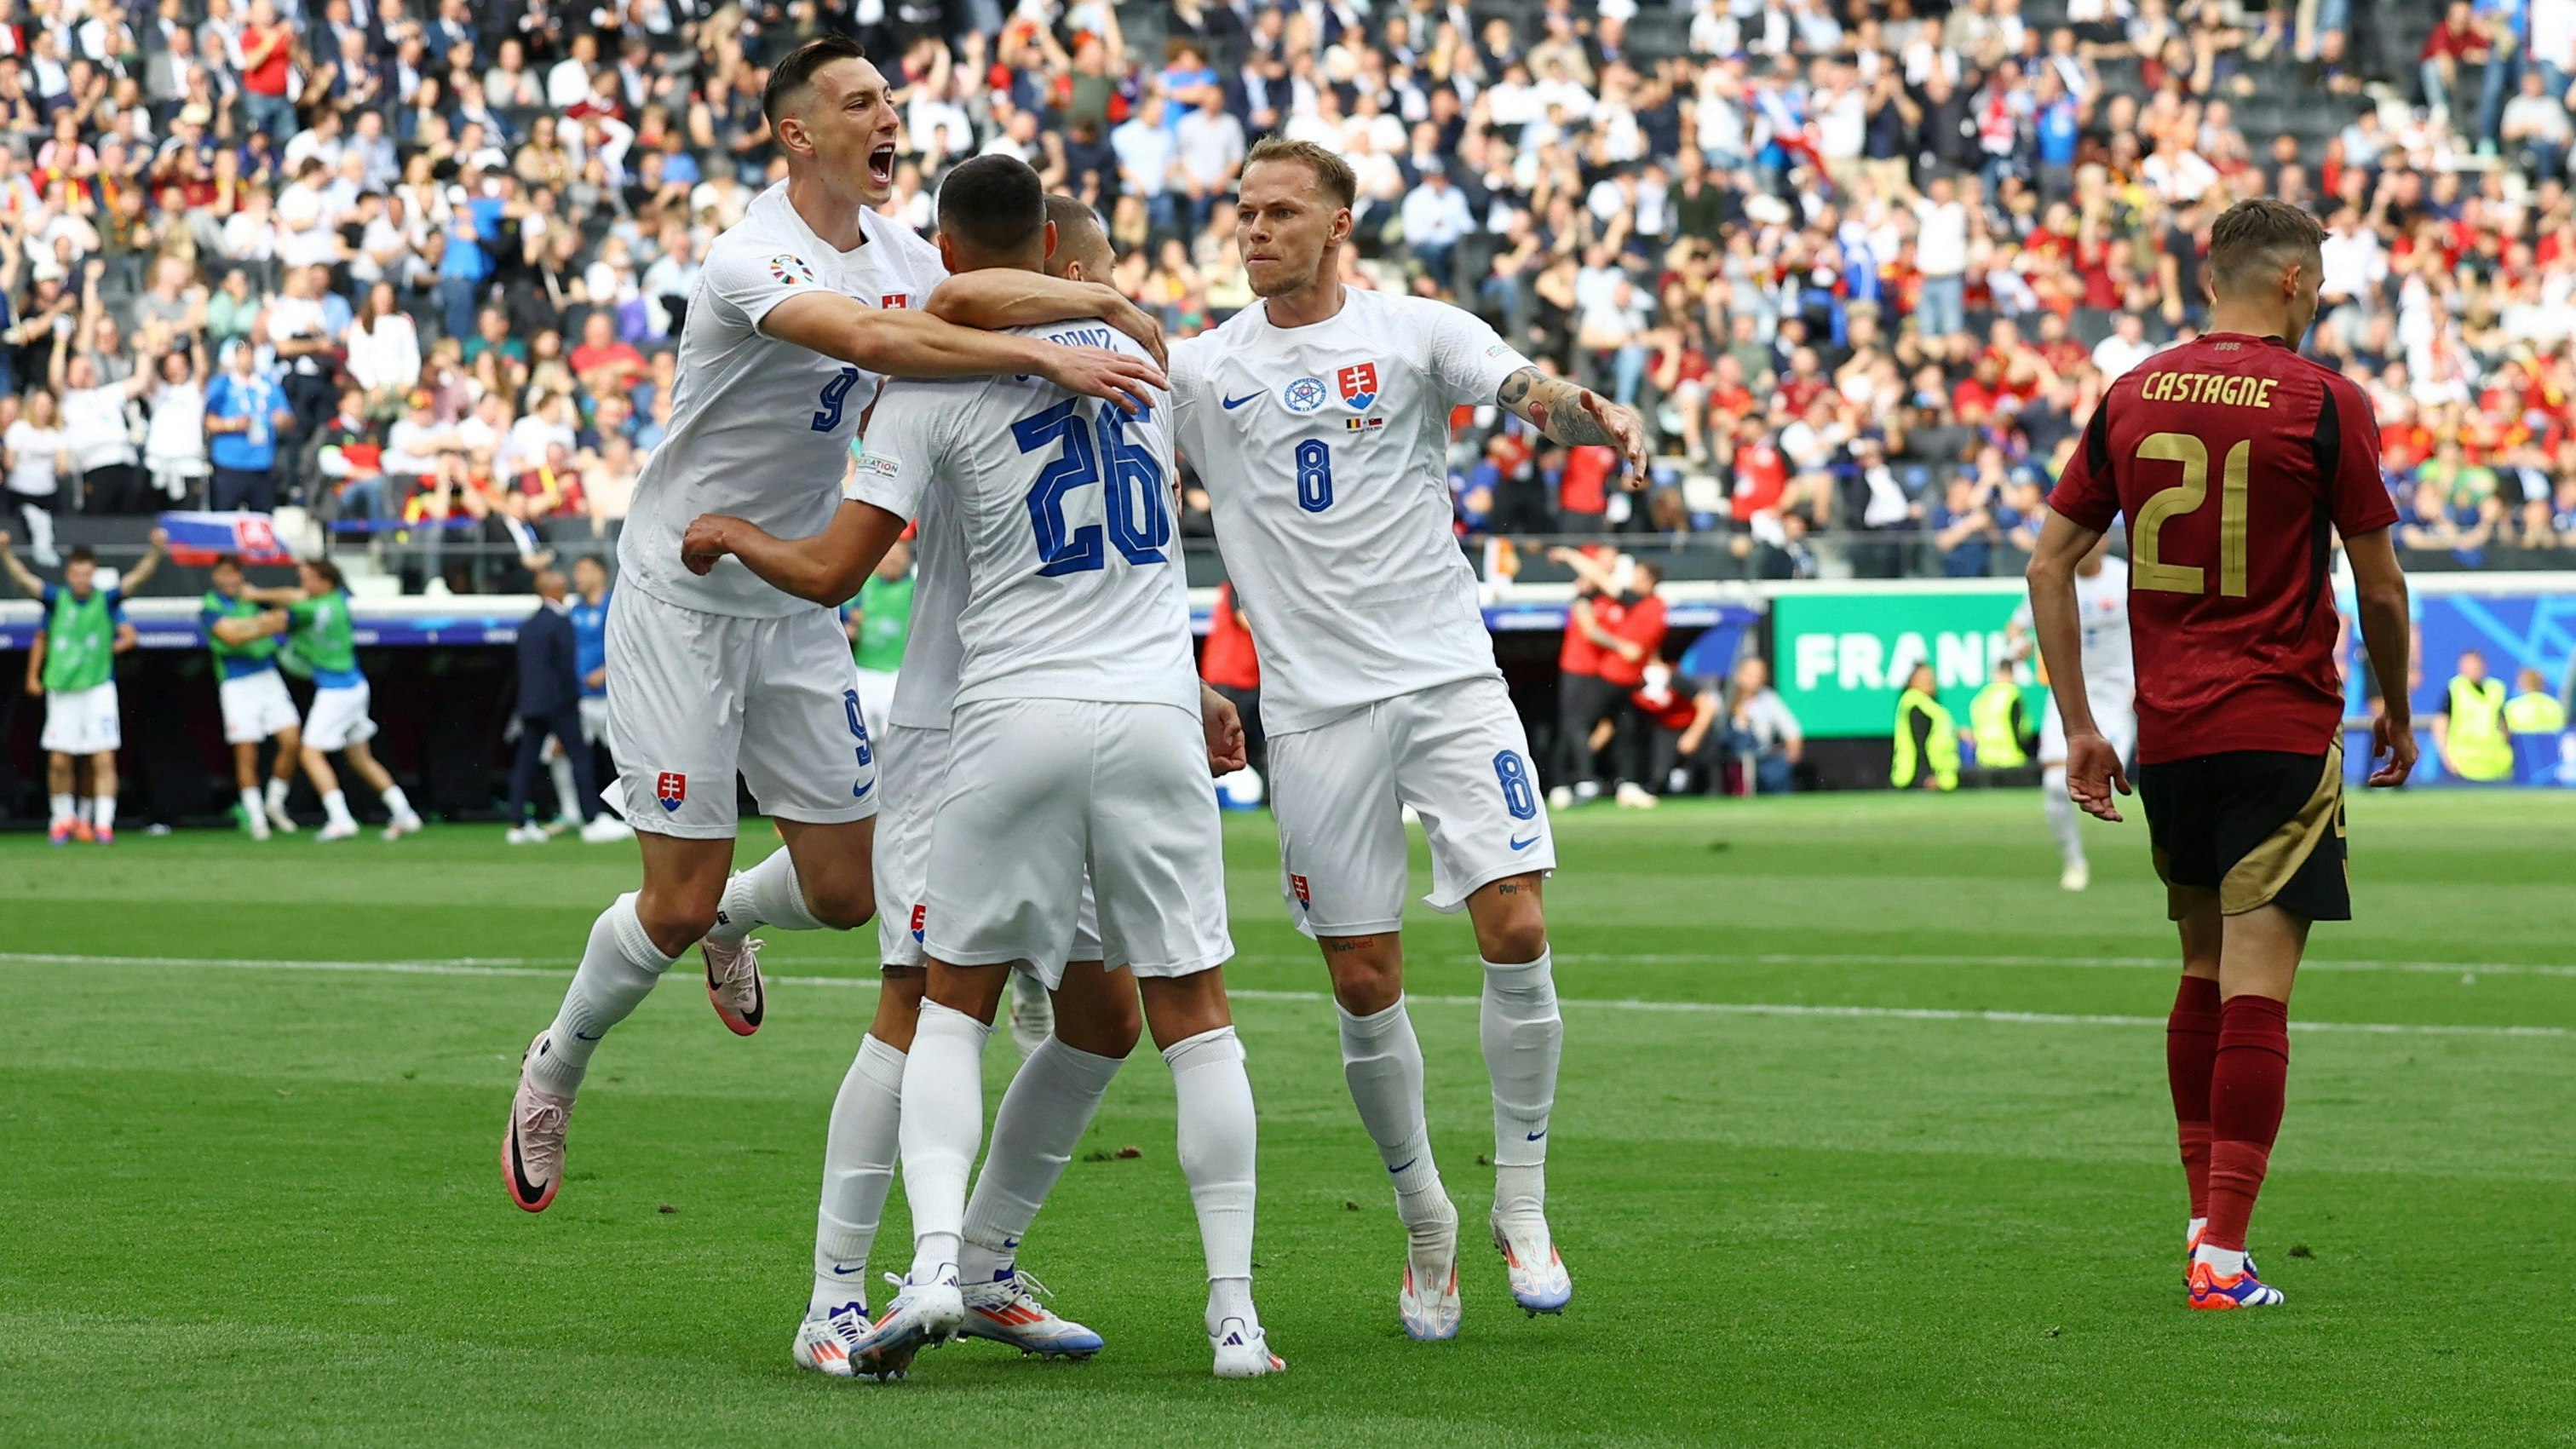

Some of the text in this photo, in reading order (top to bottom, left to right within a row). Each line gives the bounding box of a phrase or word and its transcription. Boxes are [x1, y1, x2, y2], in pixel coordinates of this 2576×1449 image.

[2213, 342, 2242, 352] 1895
[811, 366, 860, 433] 9
[2141, 370, 2279, 409] CASTAGNE
[1010, 392, 1170, 578] 26
[1295, 438, 1334, 513] 8
[2132, 431, 2251, 598] 21
[842, 688, 872, 768] 9
[1492, 749, 1537, 820] 8
